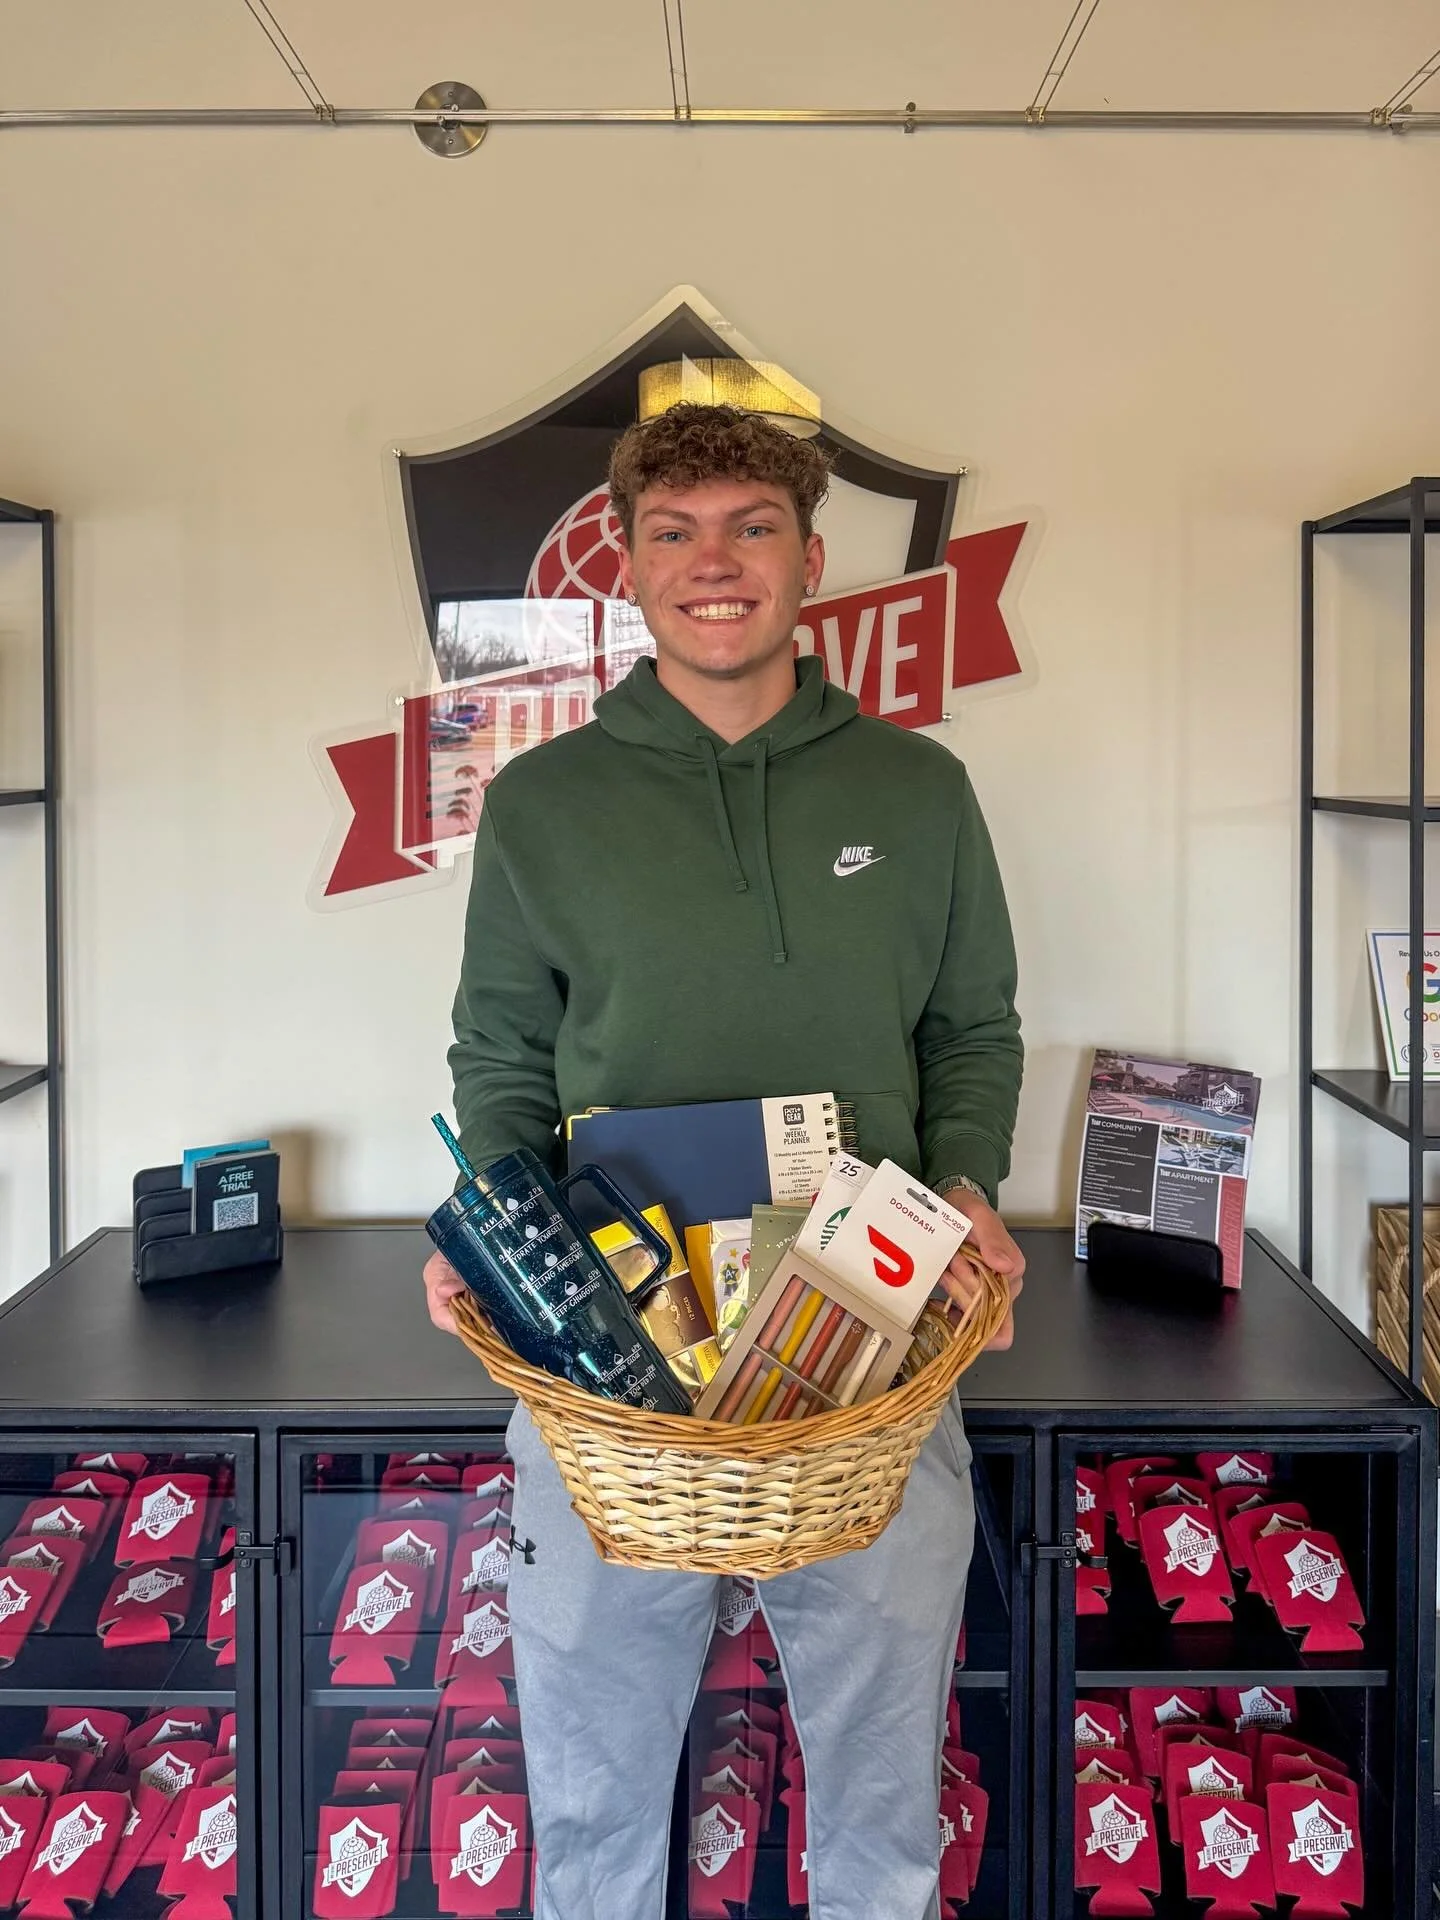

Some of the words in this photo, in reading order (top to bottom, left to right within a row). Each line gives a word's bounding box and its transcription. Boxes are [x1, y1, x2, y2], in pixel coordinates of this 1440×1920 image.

[840, 846, 874, 863] NIKE
[787, 1112, 802, 1121] GEAR
[1101, 1121, 1143, 1132] COMMUNITY
[783, 1136, 810, 1145] PLANNER
[784, 1130, 807, 1138] WEEKLY
[217, 1176, 228, 1186] A
[228, 1170, 254, 1183] FREE
[220, 1181, 251, 1193] TRIAL
[1170, 1171, 1215, 1184] APARTMENT
[889, 1197, 936, 1234] DOORDASH
[511, 1241, 537, 1263] YDRATE
[536, 1223, 564, 1244] YOURSELF
[556, 1250, 585, 1273] AWESOME
[519, 1272, 537, 1290] 10M
[568, 1281, 601, 1308] CHUGGING
[144, 1506, 186, 1526] PRESERVE
[1177, 1539, 1215, 1560] PRESERVE
[476, 1563, 509, 1581] PRESER
[1300, 1563, 1339, 1586] PRESERVE
[132, 1580, 175, 1596] PRESERVE
[358, 1598, 404, 1618] PRESERVE
[719, 1597, 757, 1620] RESERVE
[467, 1627, 510, 1644] PRESERVE
[50, 1830, 96, 1858] PRESERVE
[199, 1828, 236, 1850] PRESER
[695, 1835, 737, 1856] PRESERVE
[1100, 1826, 1141, 1845] PRESERVE
[1303, 1835, 1346, 1853] PRESERVE
[465, 1837, 509, 1866] PRESERVE
[1211, 1840, 1252, 1860] PRESERVE
[335, 1851, 380, 1876] PRESERVE
